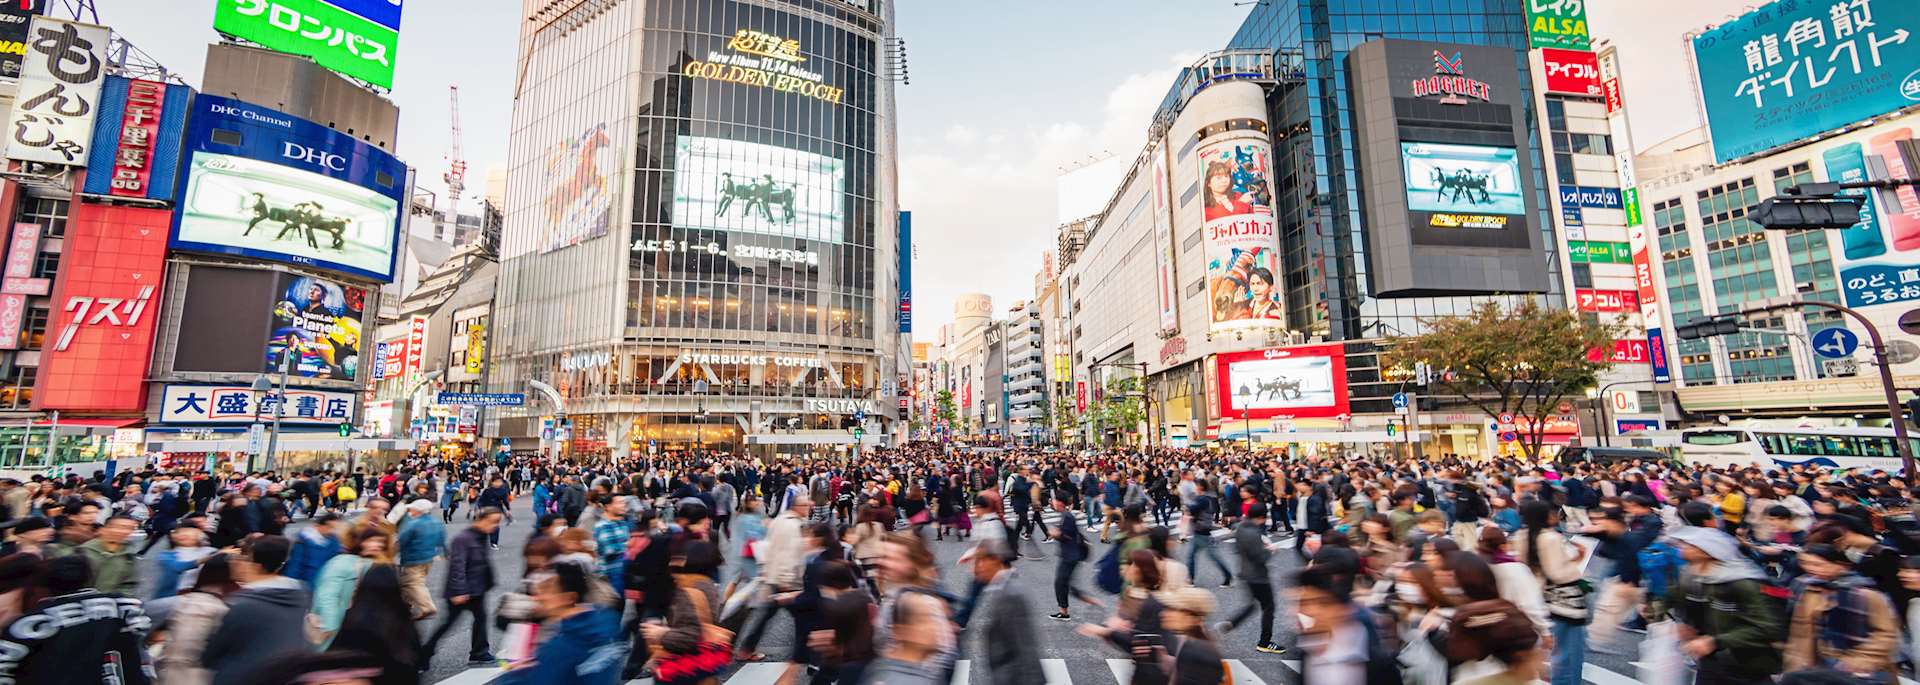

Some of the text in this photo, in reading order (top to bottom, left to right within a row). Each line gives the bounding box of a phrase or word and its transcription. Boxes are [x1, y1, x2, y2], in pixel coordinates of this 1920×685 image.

[1533, 16, 1587, 36] ALSA
[1743, 0, 1876, 74] 龍角散
[727, 29, 807, 61] 超特急
[708, 51, 822, 82] New Album 11.14 Release
[1545, 61, 1598, 79] アイフル
[1734, 28, 1910, 108] ダイレクト
[15, 23, 101, 161] もんじゃ
[685, 60, 844, 104] GOLDEN EPOCH
[1412, 77, 1491, 102] MAGNET
[211, 103, 292, 129] DHC Channel
[111, 82, 160, 191] 三千里薬品
[283, 141, 347, 172] DHC
[1562, 192, 1618, 205] レオパレス21
[1210, 220, 1273, 241] ジャパンカップ
[1581, 293, 1620, 308] アコム
[53, 285, 156, 352] クスリ
[293, 316, 345, 336] Planets
[302, 311, 334, 323] teamLab
[562, 353, 609, 370] TSUTAYA
[683, 353, 822, 368] STARBUCKS COFFEE
[174, 393, 348, 418] 大盛堂書店
[807, 400, 873, 413] TSUTAYA
